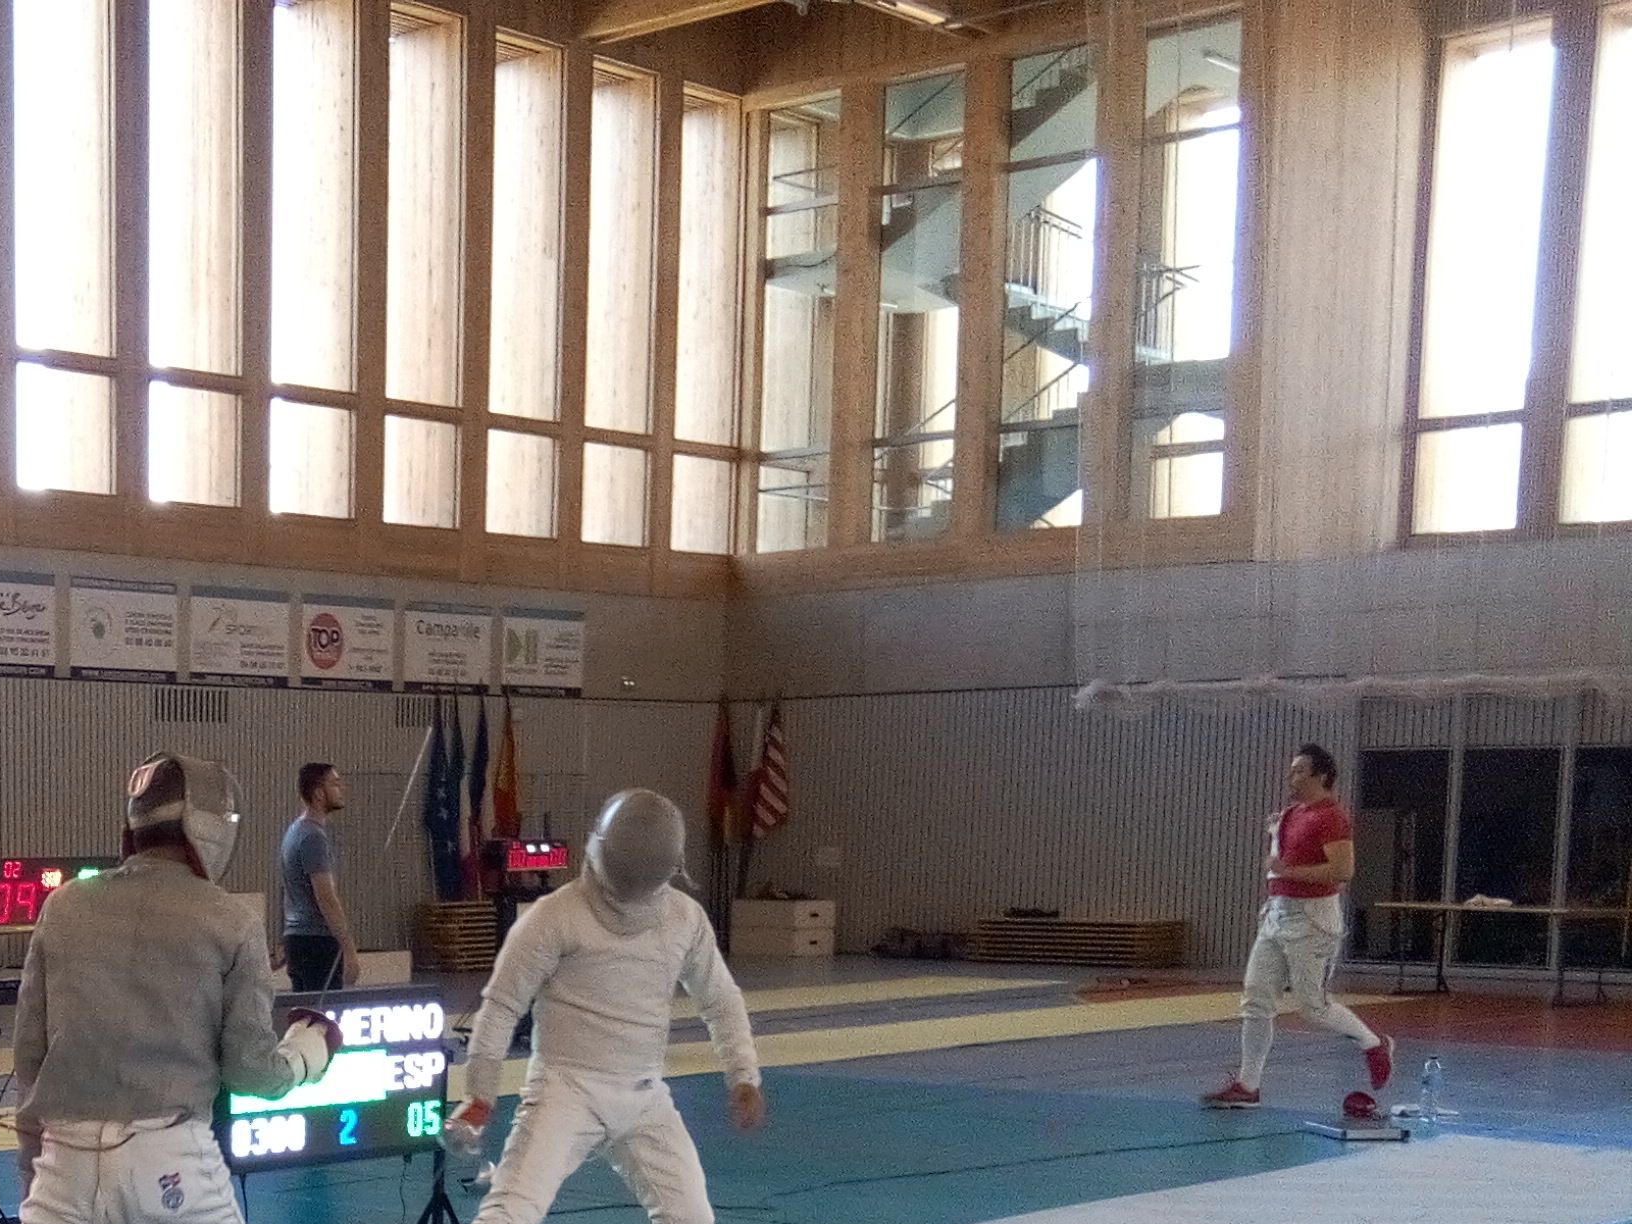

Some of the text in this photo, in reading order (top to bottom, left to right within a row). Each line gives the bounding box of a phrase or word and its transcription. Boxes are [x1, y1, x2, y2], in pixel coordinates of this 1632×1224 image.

[310, 626, 340, 650] TOP
[386, 1051, 446, 1091] ESP
[339, 1109, 358, 1145] 2
[407, 1100, 442, 1137] 05
